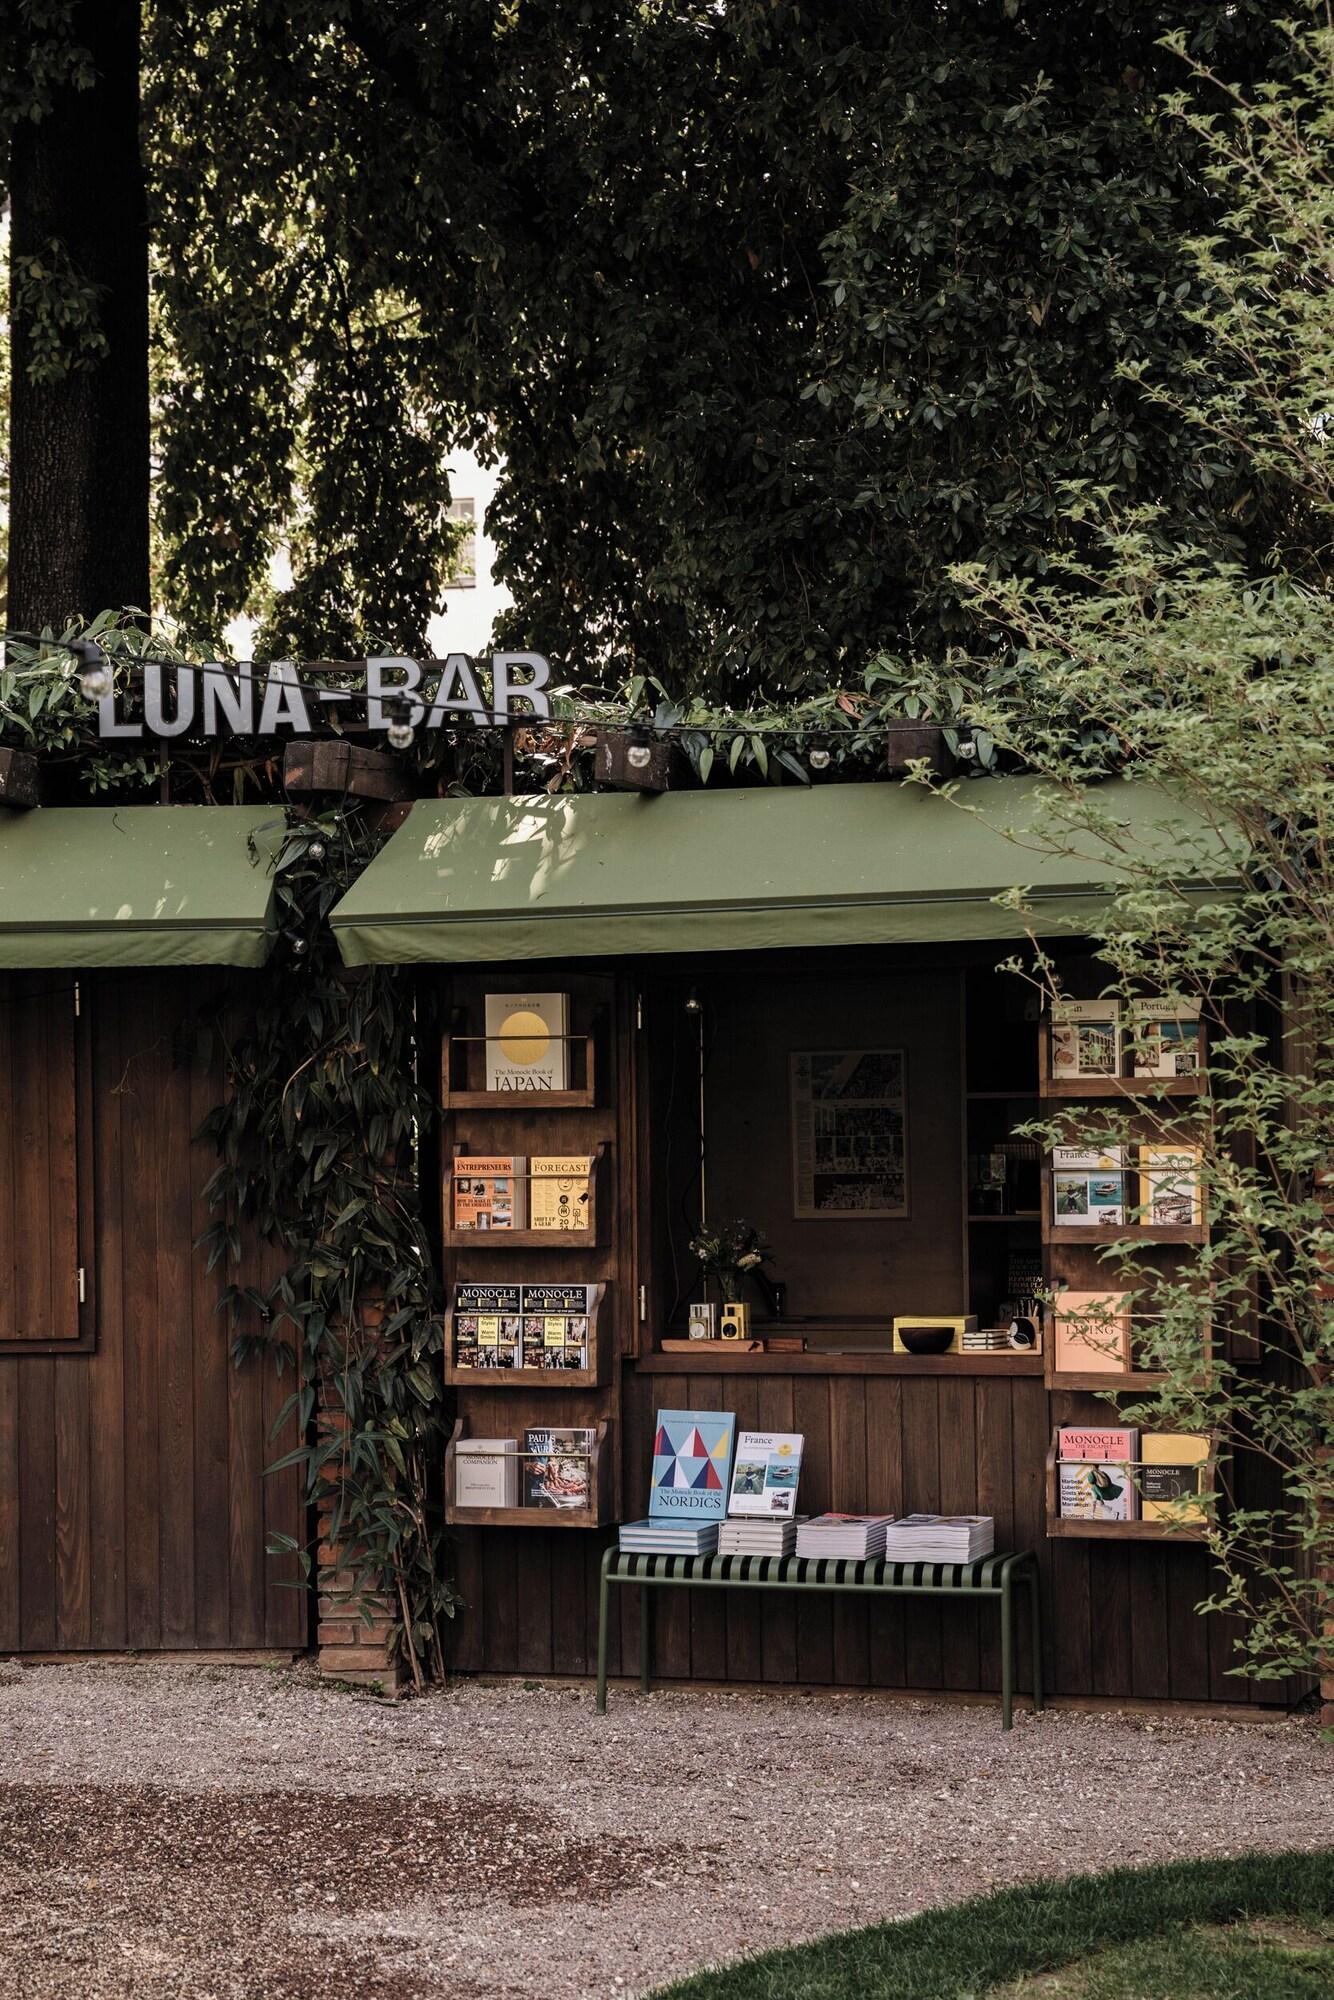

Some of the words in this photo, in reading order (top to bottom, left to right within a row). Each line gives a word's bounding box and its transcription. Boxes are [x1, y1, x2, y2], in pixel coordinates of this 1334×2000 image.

[98, 652, 553, 738] LUNA-BAR
[495, 1076, 553, 1091] JAPAN
[1060, 1150, 1090, 1159] France
[534, 1164, 588, 1172] FORECAST
[462, 1289, 516, 1298] MONOCLE
[528, 1289, 583, 1298] MONOCLE
[744, 1436, 773, 1444] France
[1064, 1435, 1124, 1445] MONOCLE
[659, 1496, 721, 1508] NORDICS
